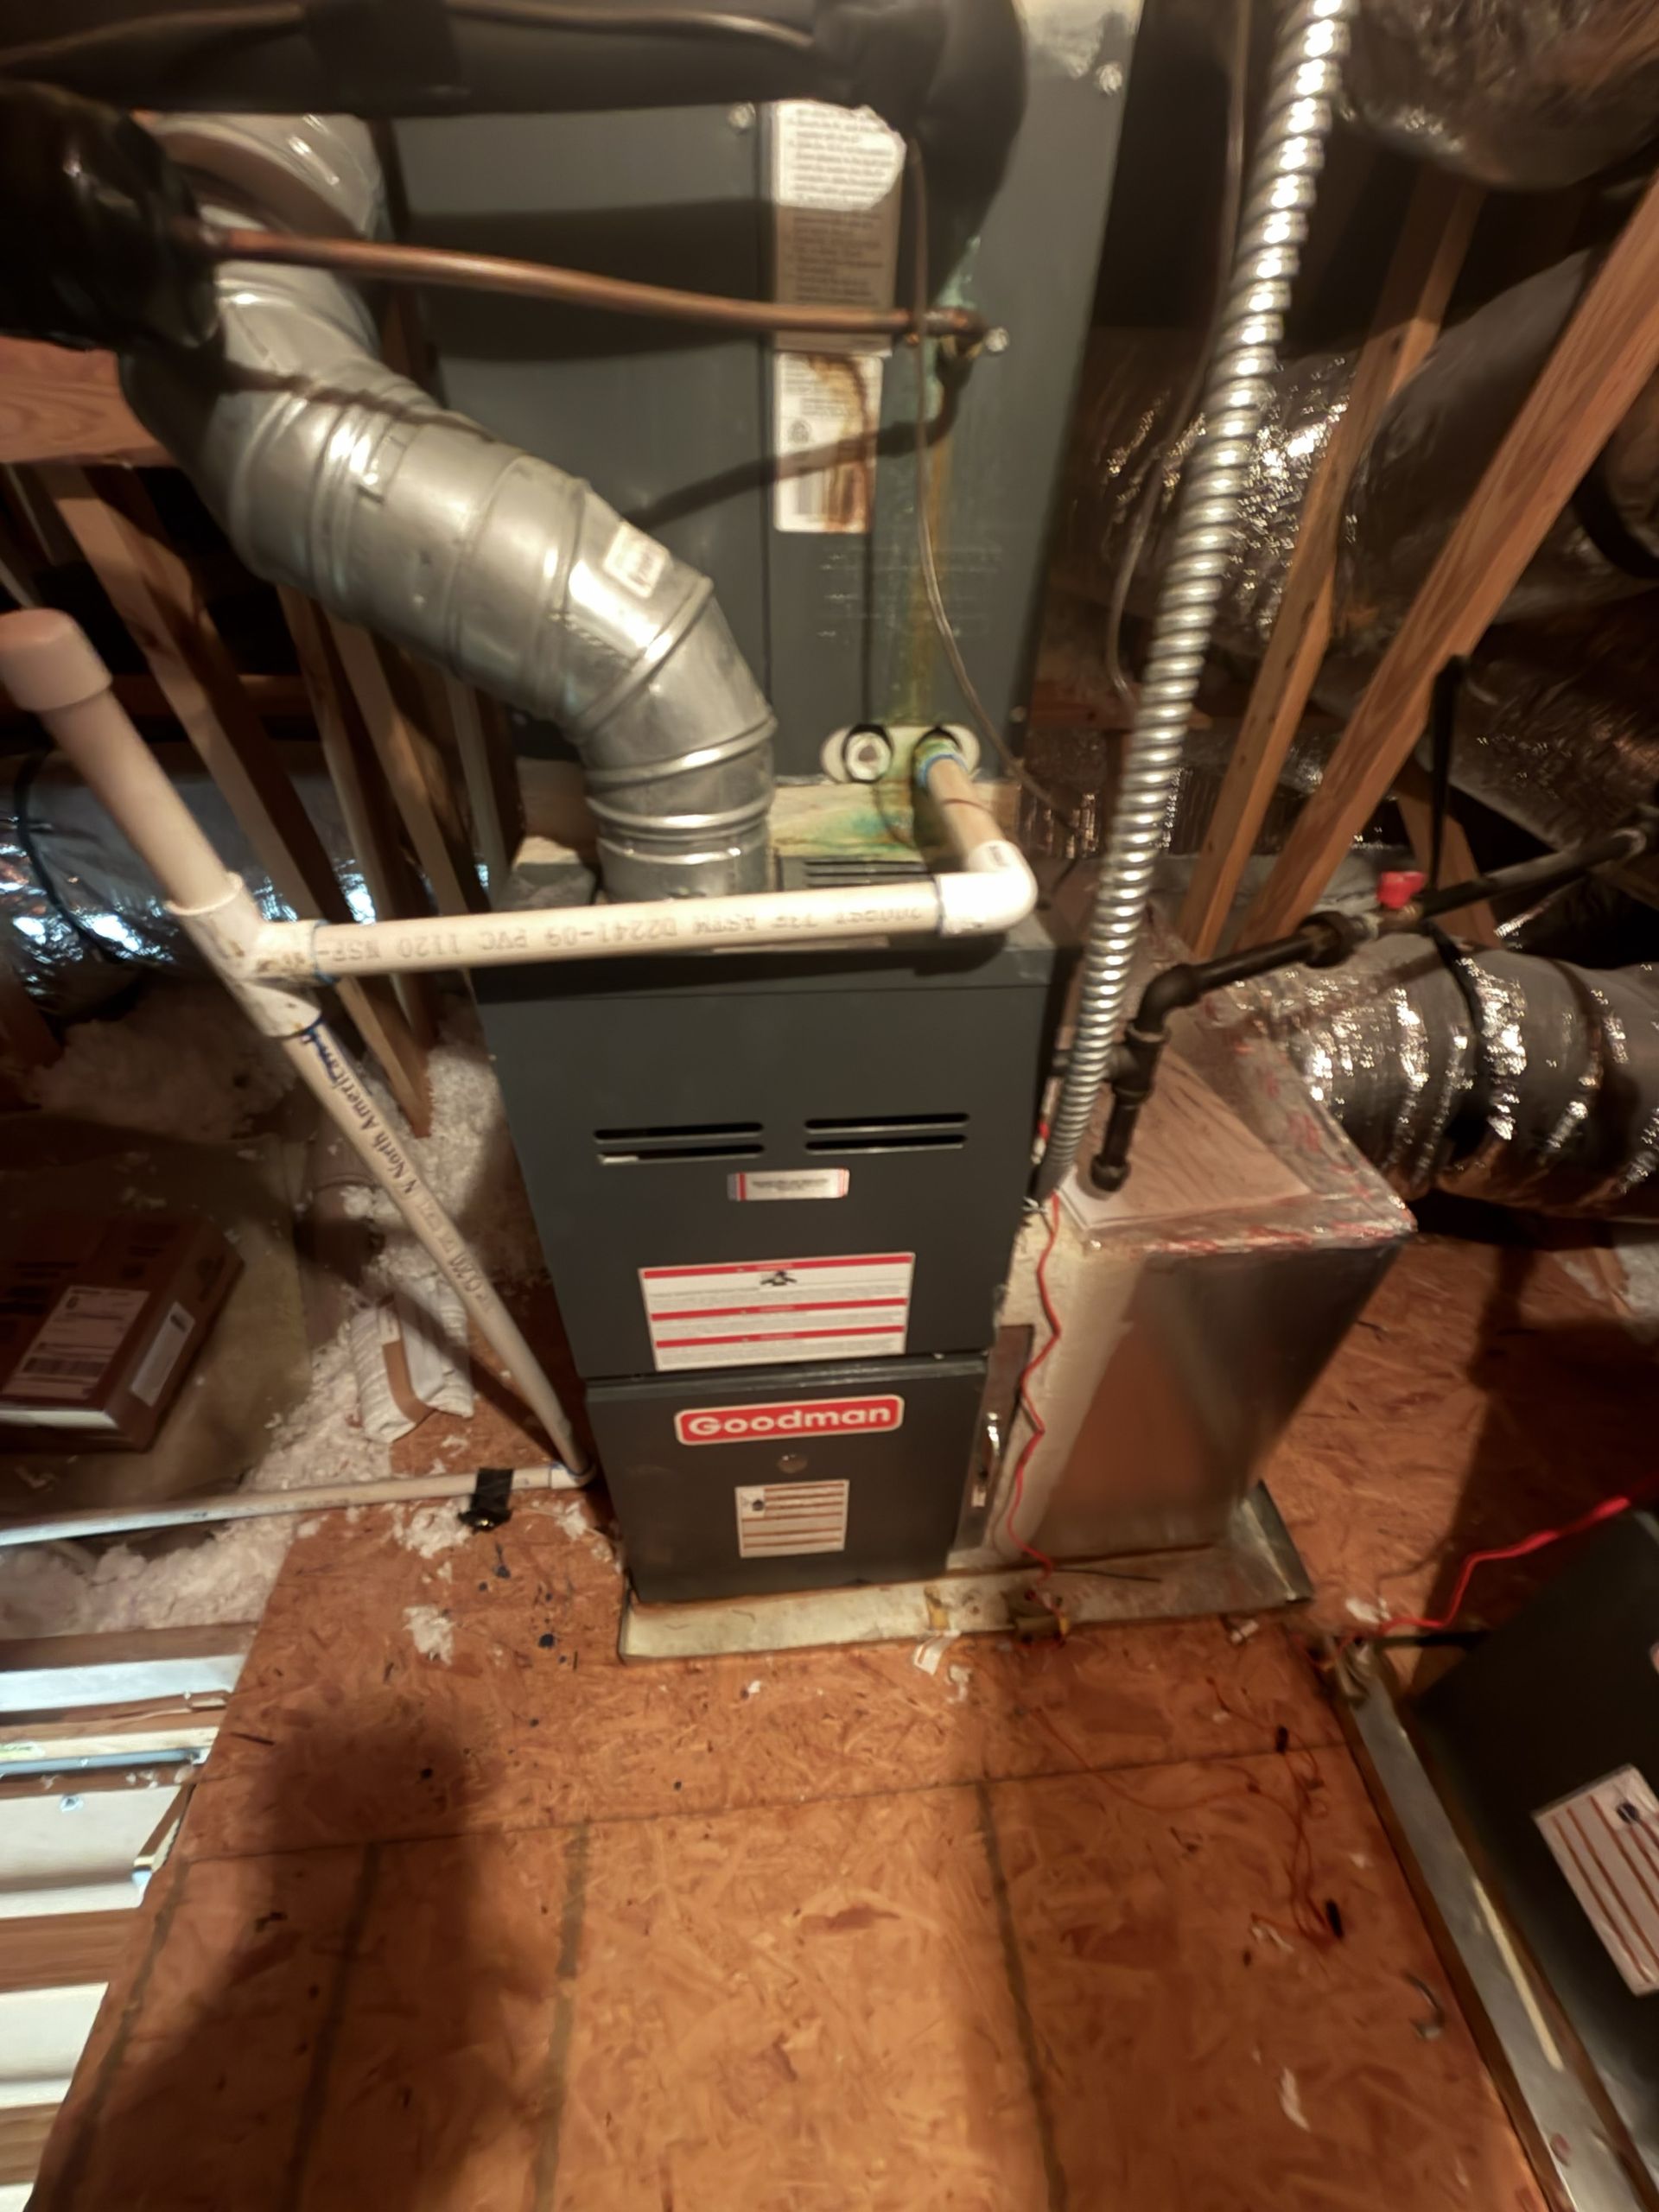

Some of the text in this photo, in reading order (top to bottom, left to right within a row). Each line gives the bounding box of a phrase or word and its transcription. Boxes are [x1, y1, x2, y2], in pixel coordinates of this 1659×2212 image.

[397, 934, 462, 959] 1120
[477, 930, 529, 950] PVC
[373, 1131, 406, 1179] North
[688, 1407, 891, 1436] Goodman
